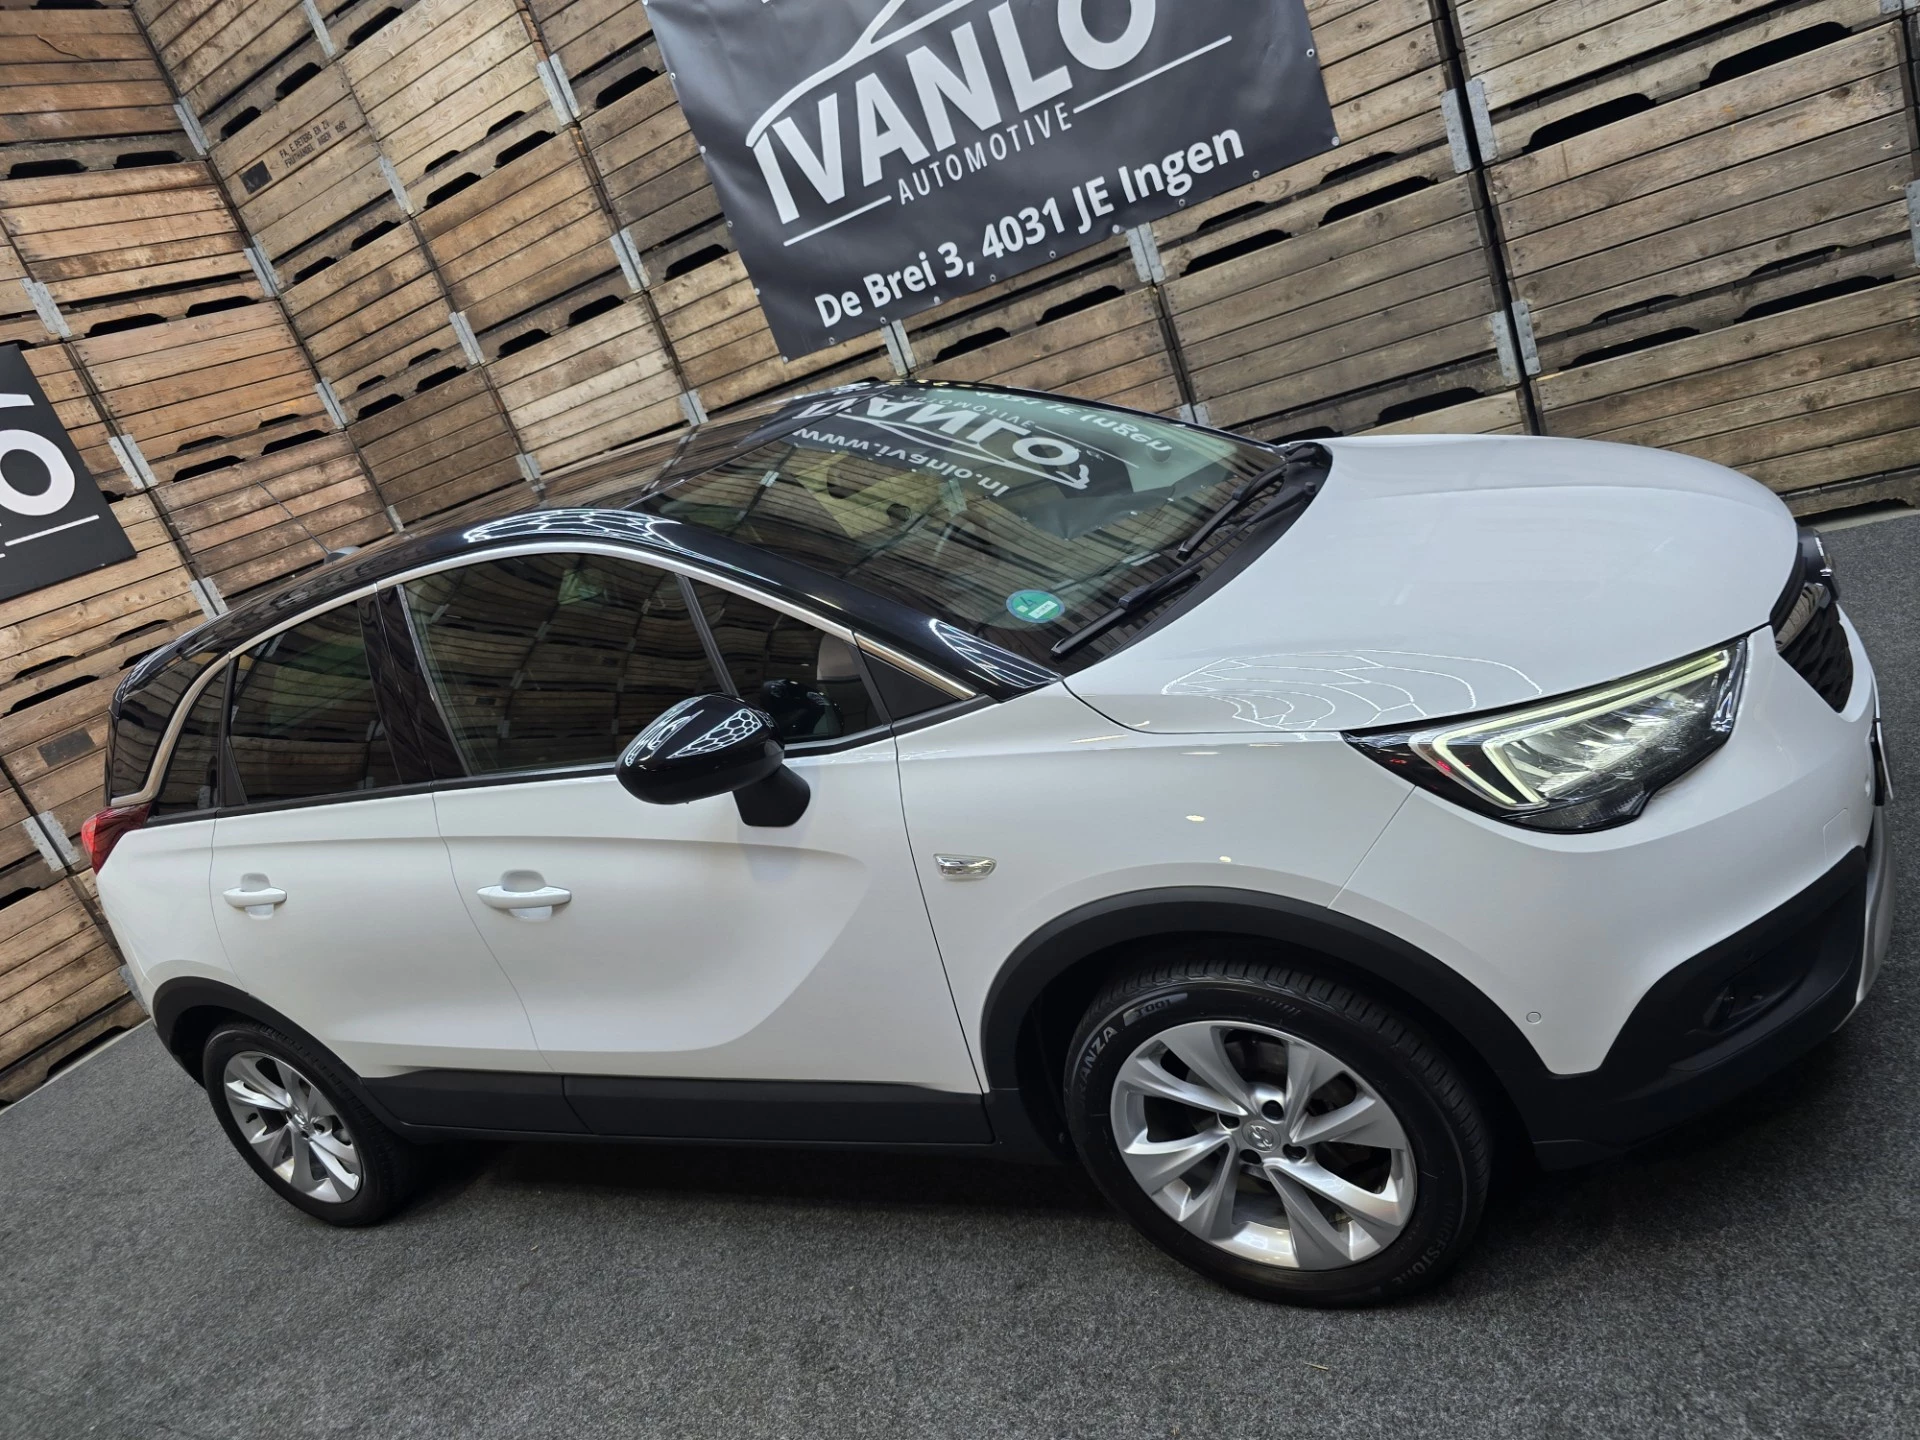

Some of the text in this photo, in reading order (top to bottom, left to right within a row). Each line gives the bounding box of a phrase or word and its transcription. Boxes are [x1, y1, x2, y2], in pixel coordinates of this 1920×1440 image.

[752, 0, 1155, 224] IVANLO
[897, 103, 1073, 206] AUTOMOTIVE
[814, 128, 1245, 328] De Brei 3, 4031 JE Ingen
